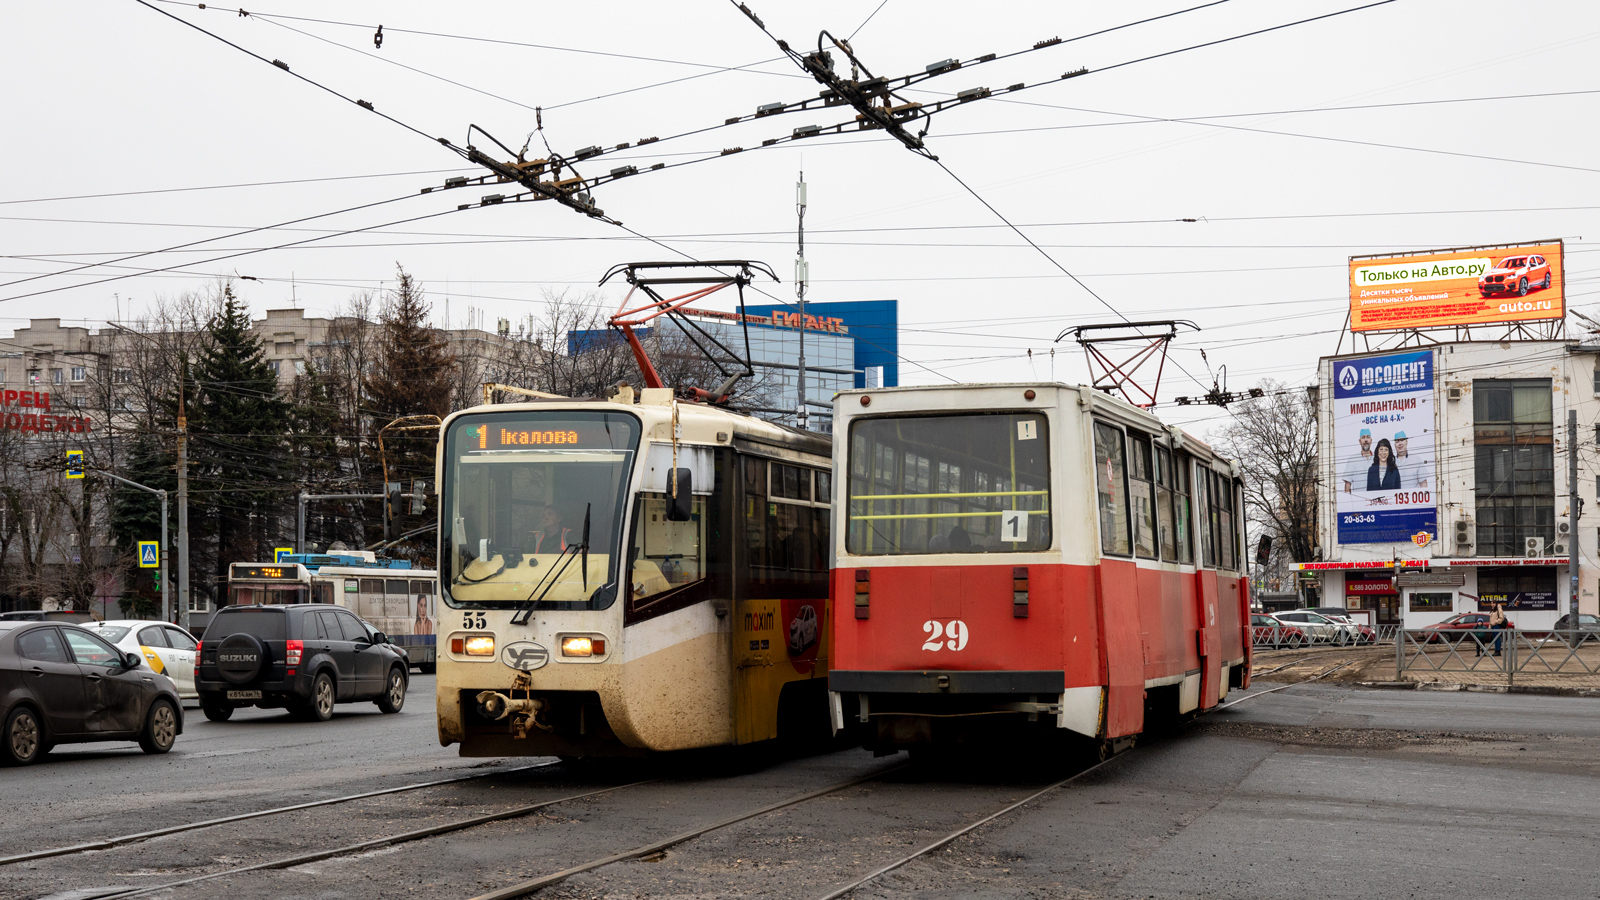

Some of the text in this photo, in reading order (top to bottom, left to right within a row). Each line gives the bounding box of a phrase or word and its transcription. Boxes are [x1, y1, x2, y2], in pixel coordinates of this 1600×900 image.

[1360, 263, 1486, 282] Только на Авто.ру
[1360, 289, 1390, 298] Десятки
[1360, 292, 1448, 306] уникальных объявлений
[1499, 300, 1551, 313] auto.ru
[772, 310, 843, 332] ГИГАНТ
[1362, 361, 1427, 386] ЮСОДЕНТ
[0, 390, 51, 412] РЕЦ
[1350, 398, 1416, 414] ИМПЛАНТАЦИЯ
[0, 412, 91, 434] ОДЕЖИ
[1380, 415, 1388, 423] НА
[477, 425, 486, 448] 1
[1395, 492, 1409, 504] 193
[1412, 491, 1430, 504] 000
[1007, 516, 1018, 537] 1
[1344, 515, 1375, 523] 20-83-63
[463, 612, 486, 629] 55
[922, 620, 969, 652] 29
